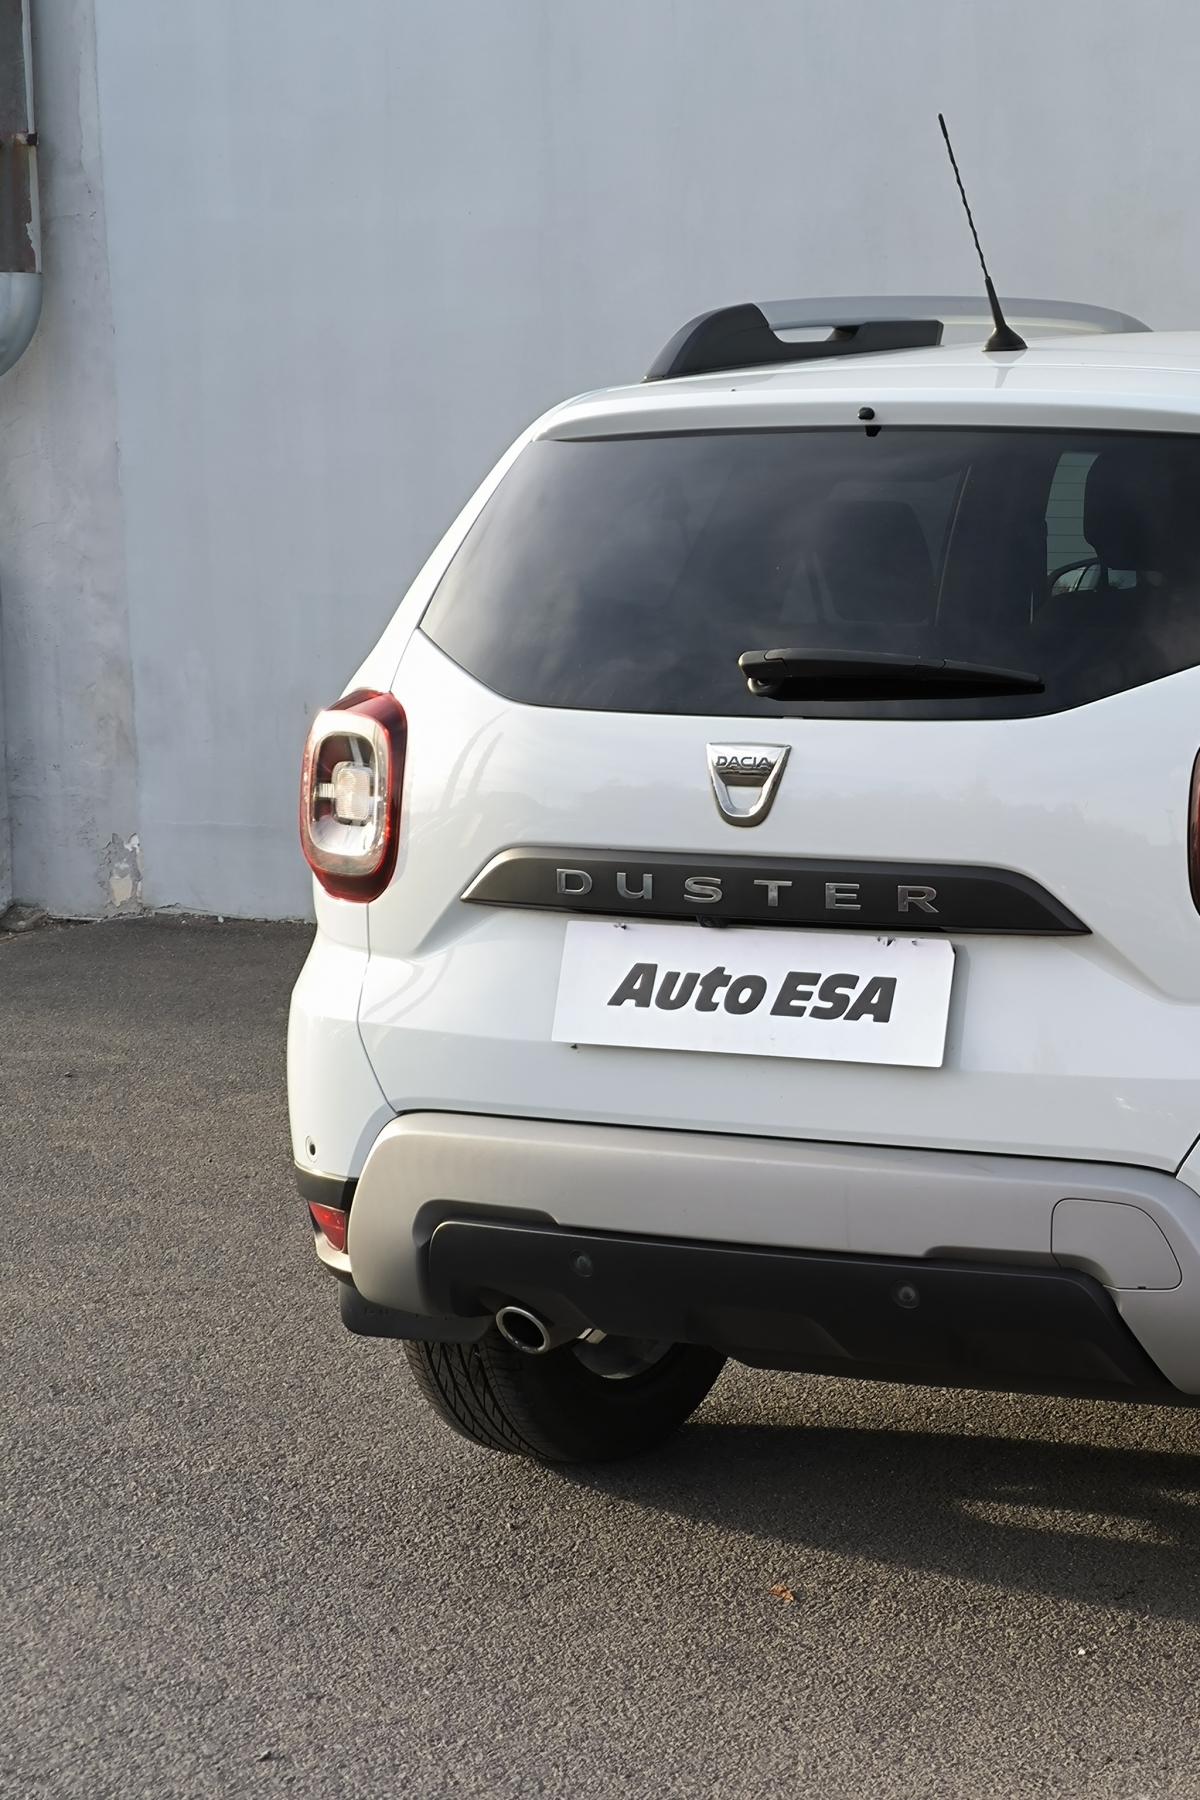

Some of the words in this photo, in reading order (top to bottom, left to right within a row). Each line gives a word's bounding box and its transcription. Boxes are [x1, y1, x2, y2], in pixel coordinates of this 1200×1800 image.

[715, 755, 772, 768] DACIA
[556, 868, 939, 913] DUSTER
[607, 962, 767, 1015] Auto
[769, 971, 897, 1023] ESA
